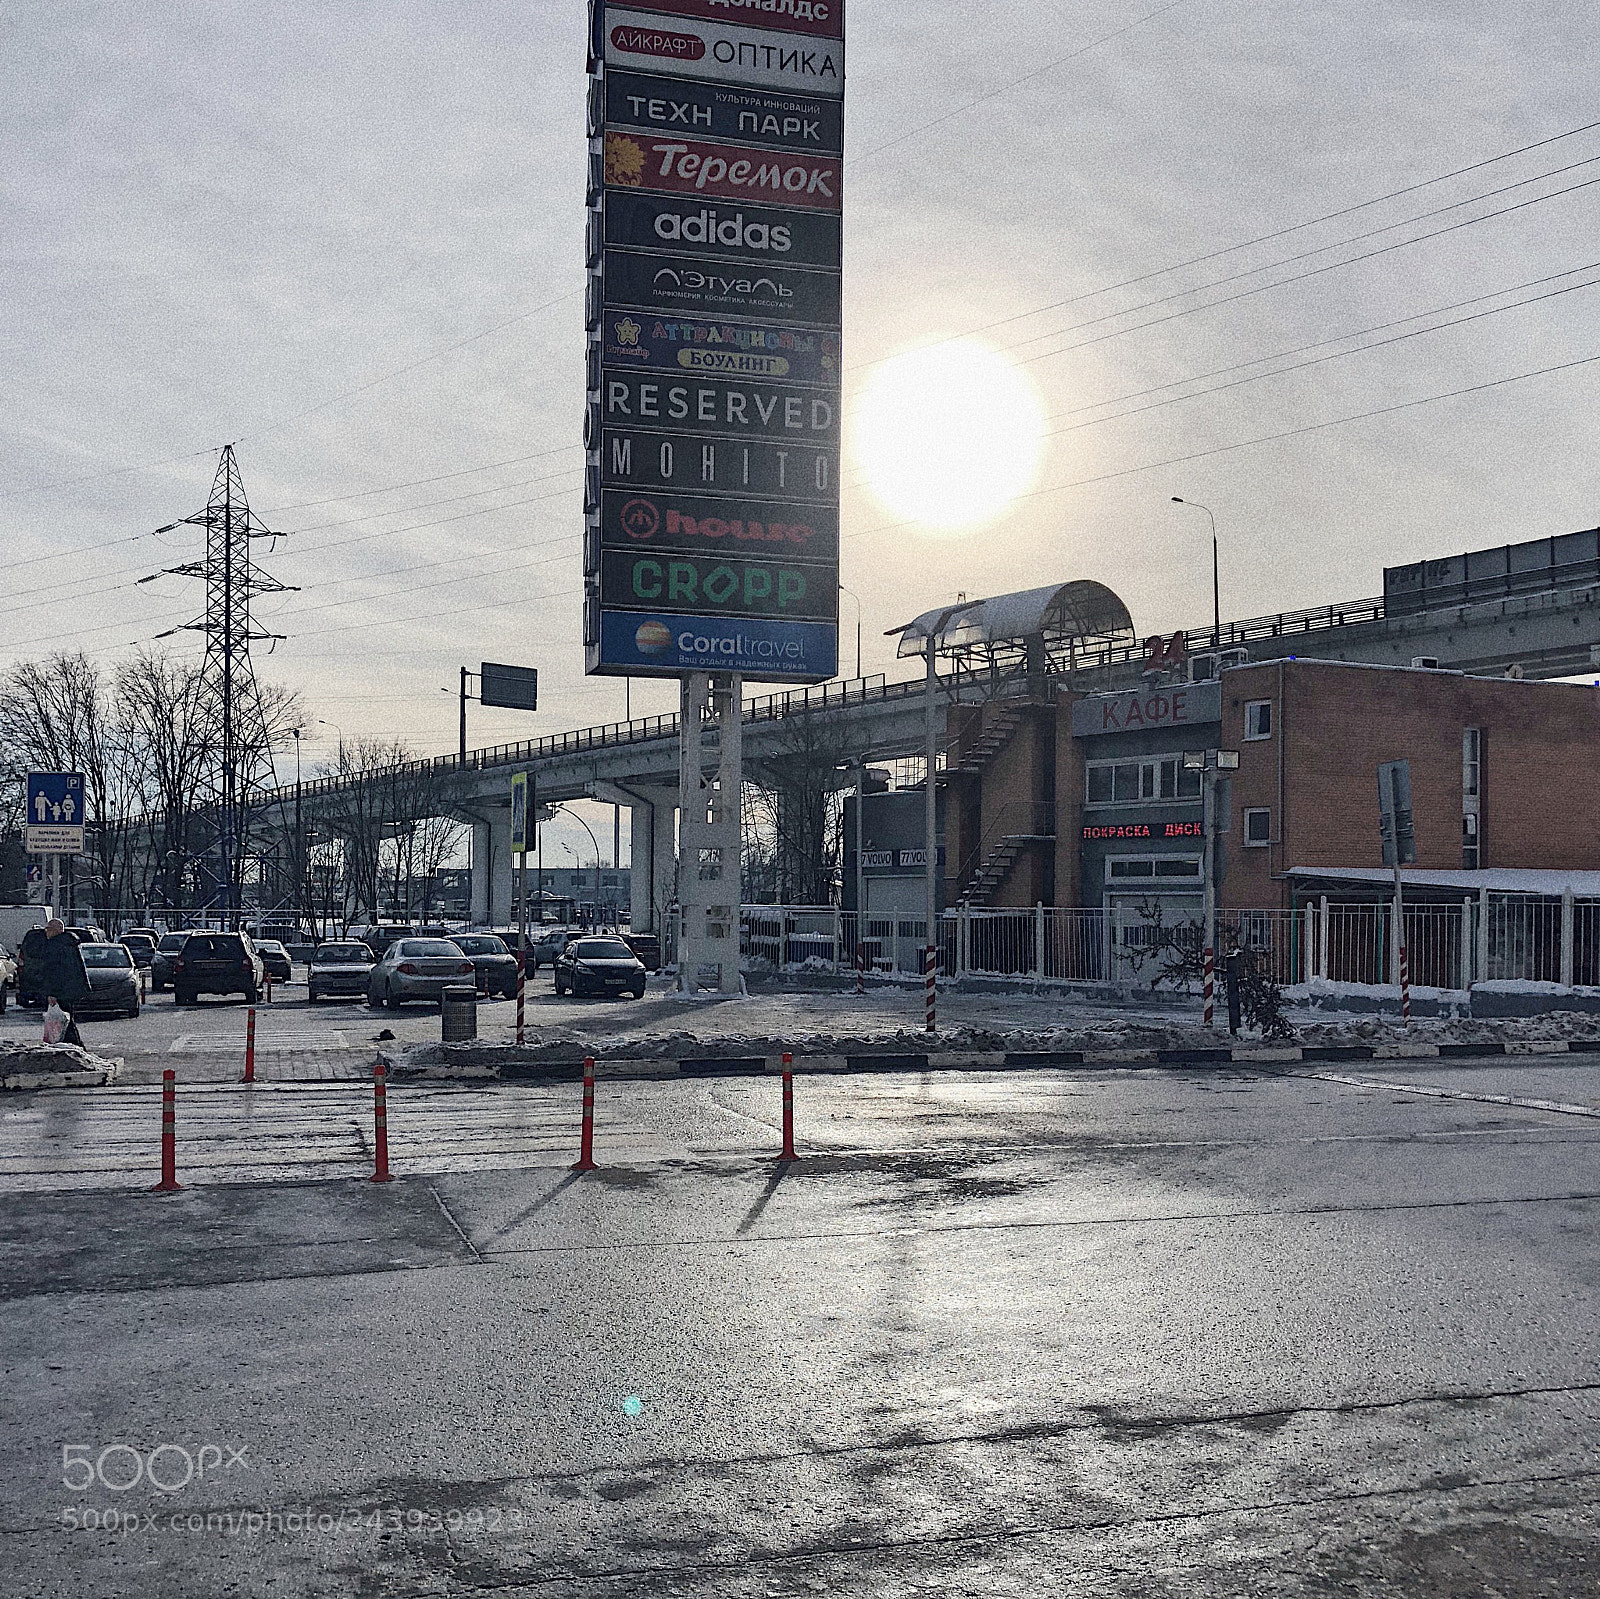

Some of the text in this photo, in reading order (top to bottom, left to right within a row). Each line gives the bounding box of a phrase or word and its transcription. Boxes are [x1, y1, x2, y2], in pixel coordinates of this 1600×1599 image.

[615, 30, 837, 79] АЙКРАФТ ОПТИКА
[626, 95, 821, 141] ТЕХН ПАРК
[715, 92, 821, 115] КУЛЬТУРА ИННОВАЦИЙ
[652, 144, 834, 198] Теремок
[654, 209, 792, 252] adidas
[652, 321, 815, 352] АТТРАКЦИОНЫ
[690, 351, 777, 373] БОУЛИНГ
[608, 381, 832, 430] RESERVED
[612, 438, 828, 491] MOHITO
[666, 509, 817, 543] house
[632, 560, 807, 607] CROPP
[1144, 630, 1187, 672] 24
[1101, 692, 1189, 729] КАФЕ
[1083, 822, 1203, 839] ПОКРАСКА ДИСК
